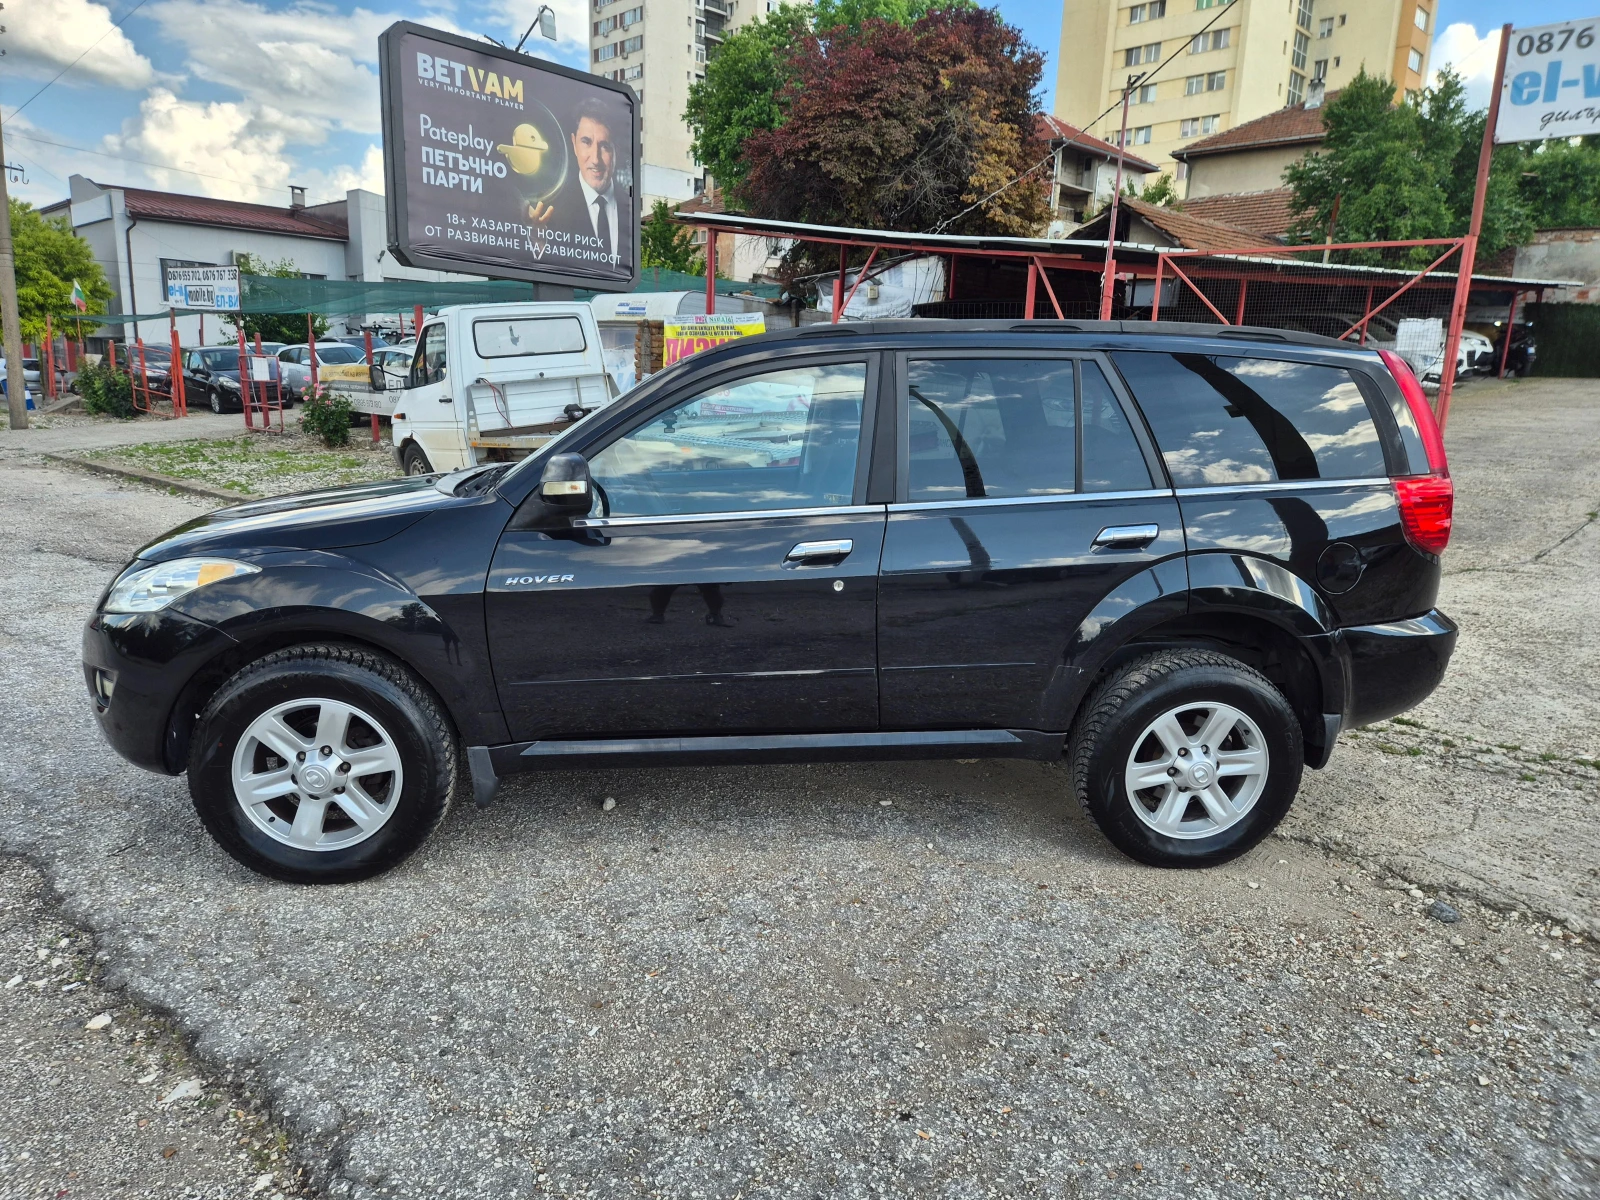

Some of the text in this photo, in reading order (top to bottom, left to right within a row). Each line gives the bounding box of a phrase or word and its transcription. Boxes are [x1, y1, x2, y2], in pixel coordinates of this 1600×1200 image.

[1517, 25, 1595, 57] 0876
[418, 78, 524, 111] VERY IMPORTANT PLAYER
[419, 113, 494, 156] Pateplay
[421, 146, 508, 179] ПЕТЪЧНО
[422, 167, 483, 194] ПАРТИ
[424, 225, 622, 265] ОТ РАЗВИВАНЕ НА ЗАВИСИМОСТ
[446, 213, 604, 249] 18+ ХАЗАРТЪТ НОСИ РИСК
[187, 287, 215, 305] mobile.bg
[504, 574, 575, 586] HOVER
